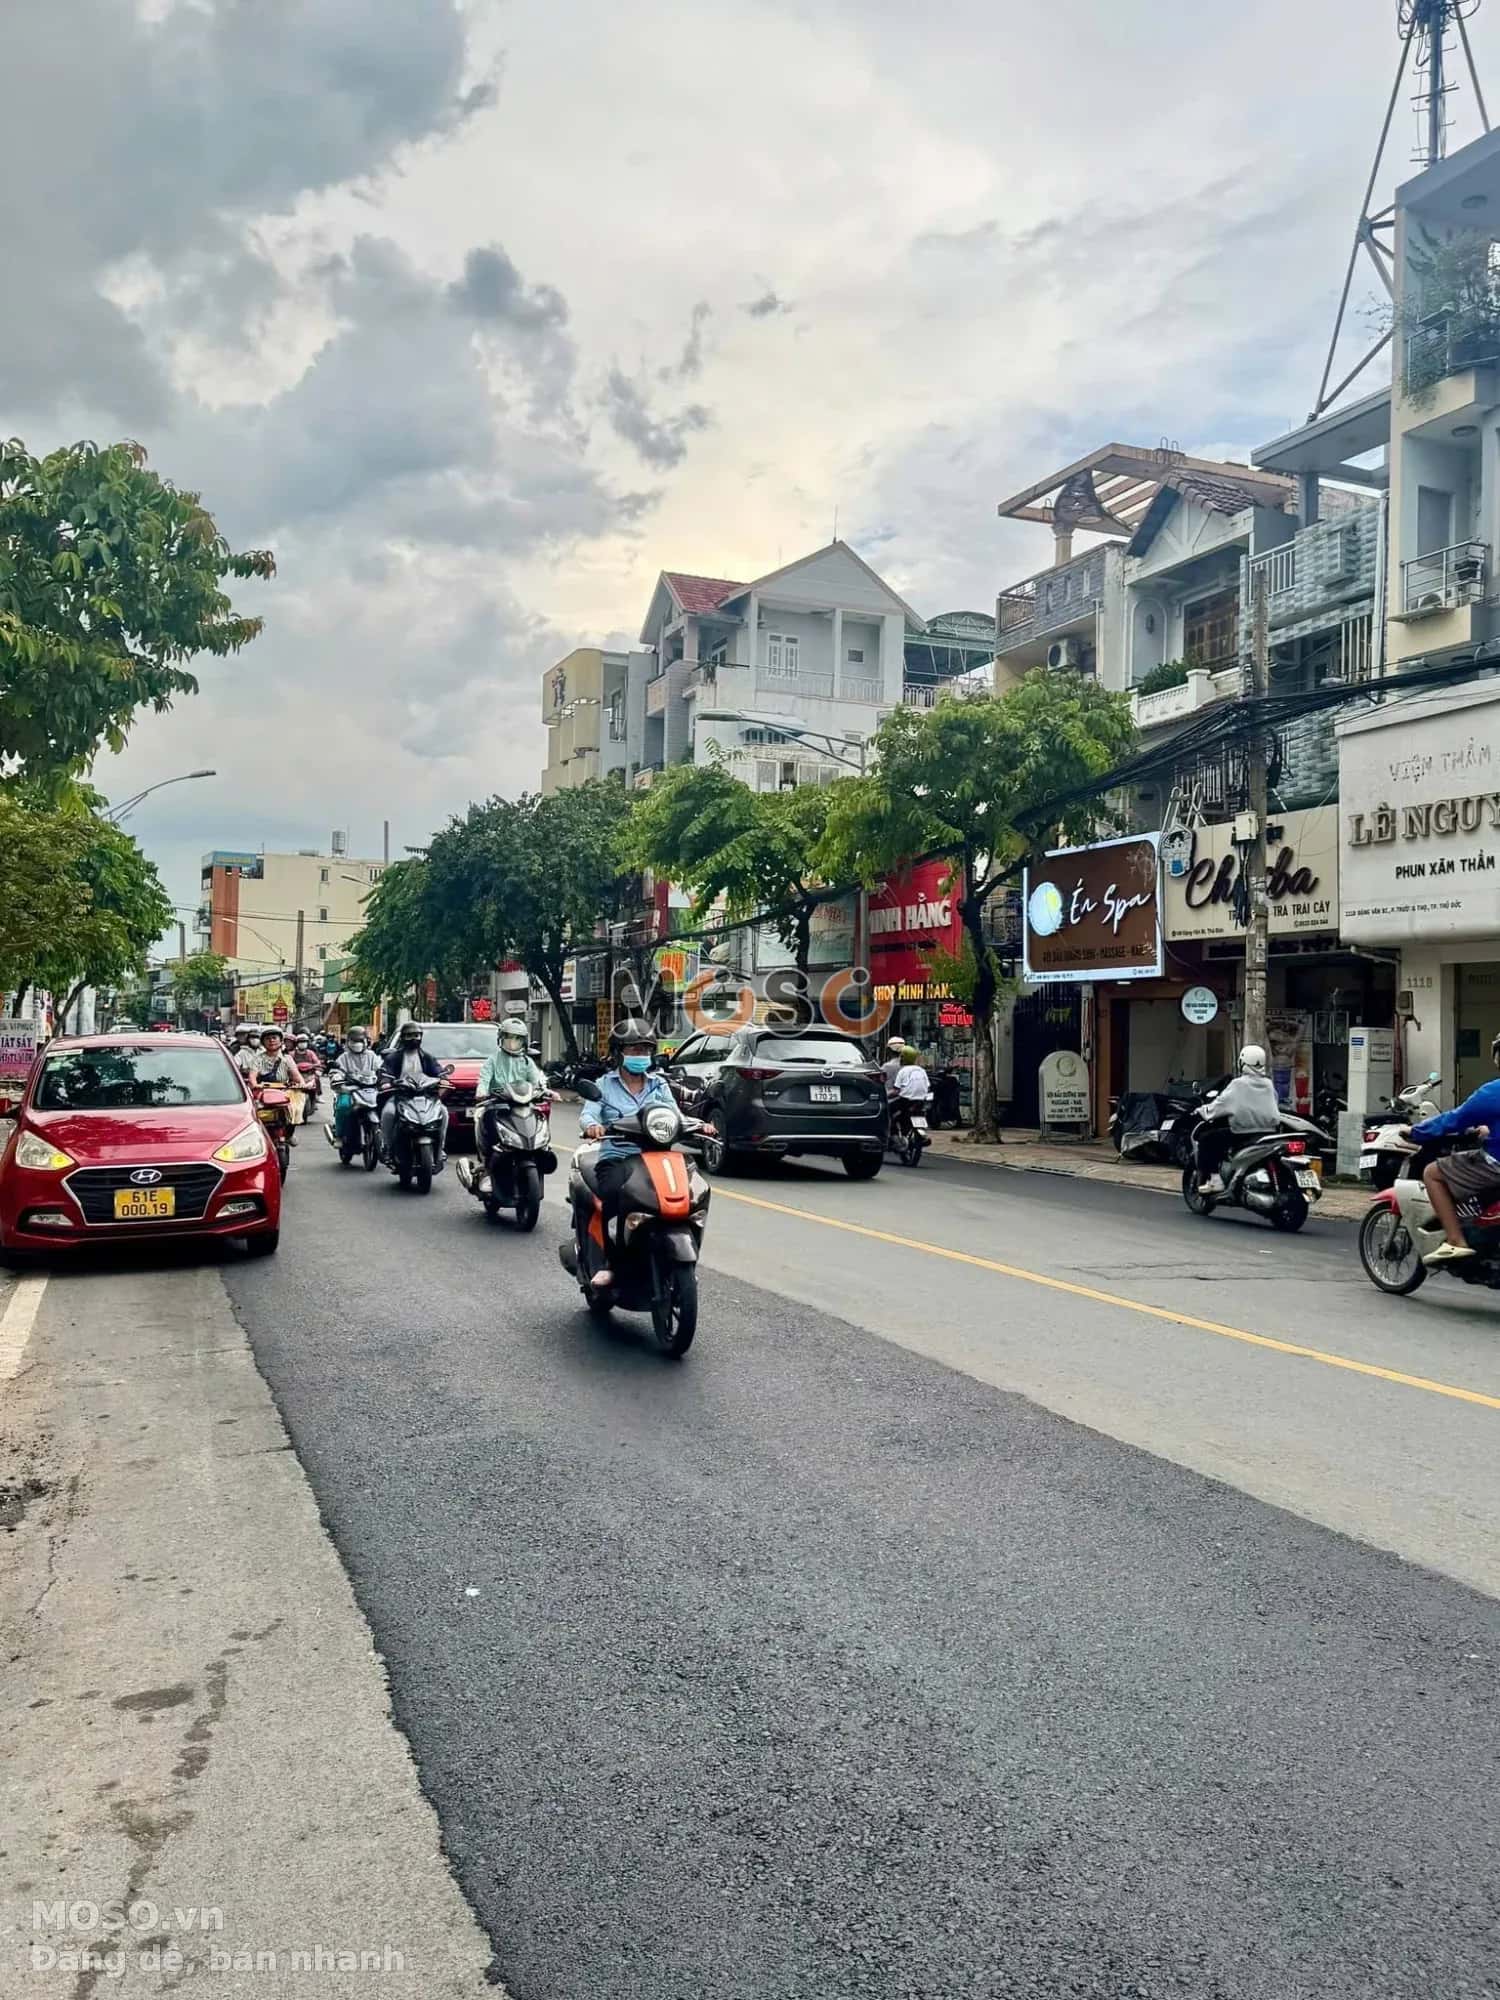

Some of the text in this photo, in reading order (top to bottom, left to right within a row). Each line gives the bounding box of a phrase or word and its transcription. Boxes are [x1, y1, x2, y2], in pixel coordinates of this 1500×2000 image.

[1395, 848, 1496, 880] PHUN XĂM THẨM
[1101, 883, 1152, 935] Spa
[873, 984, 896, 1001] SHOP
[132, 1190, 158, 1203] 61E
[121, 1202, 168, 1217] 000.19
